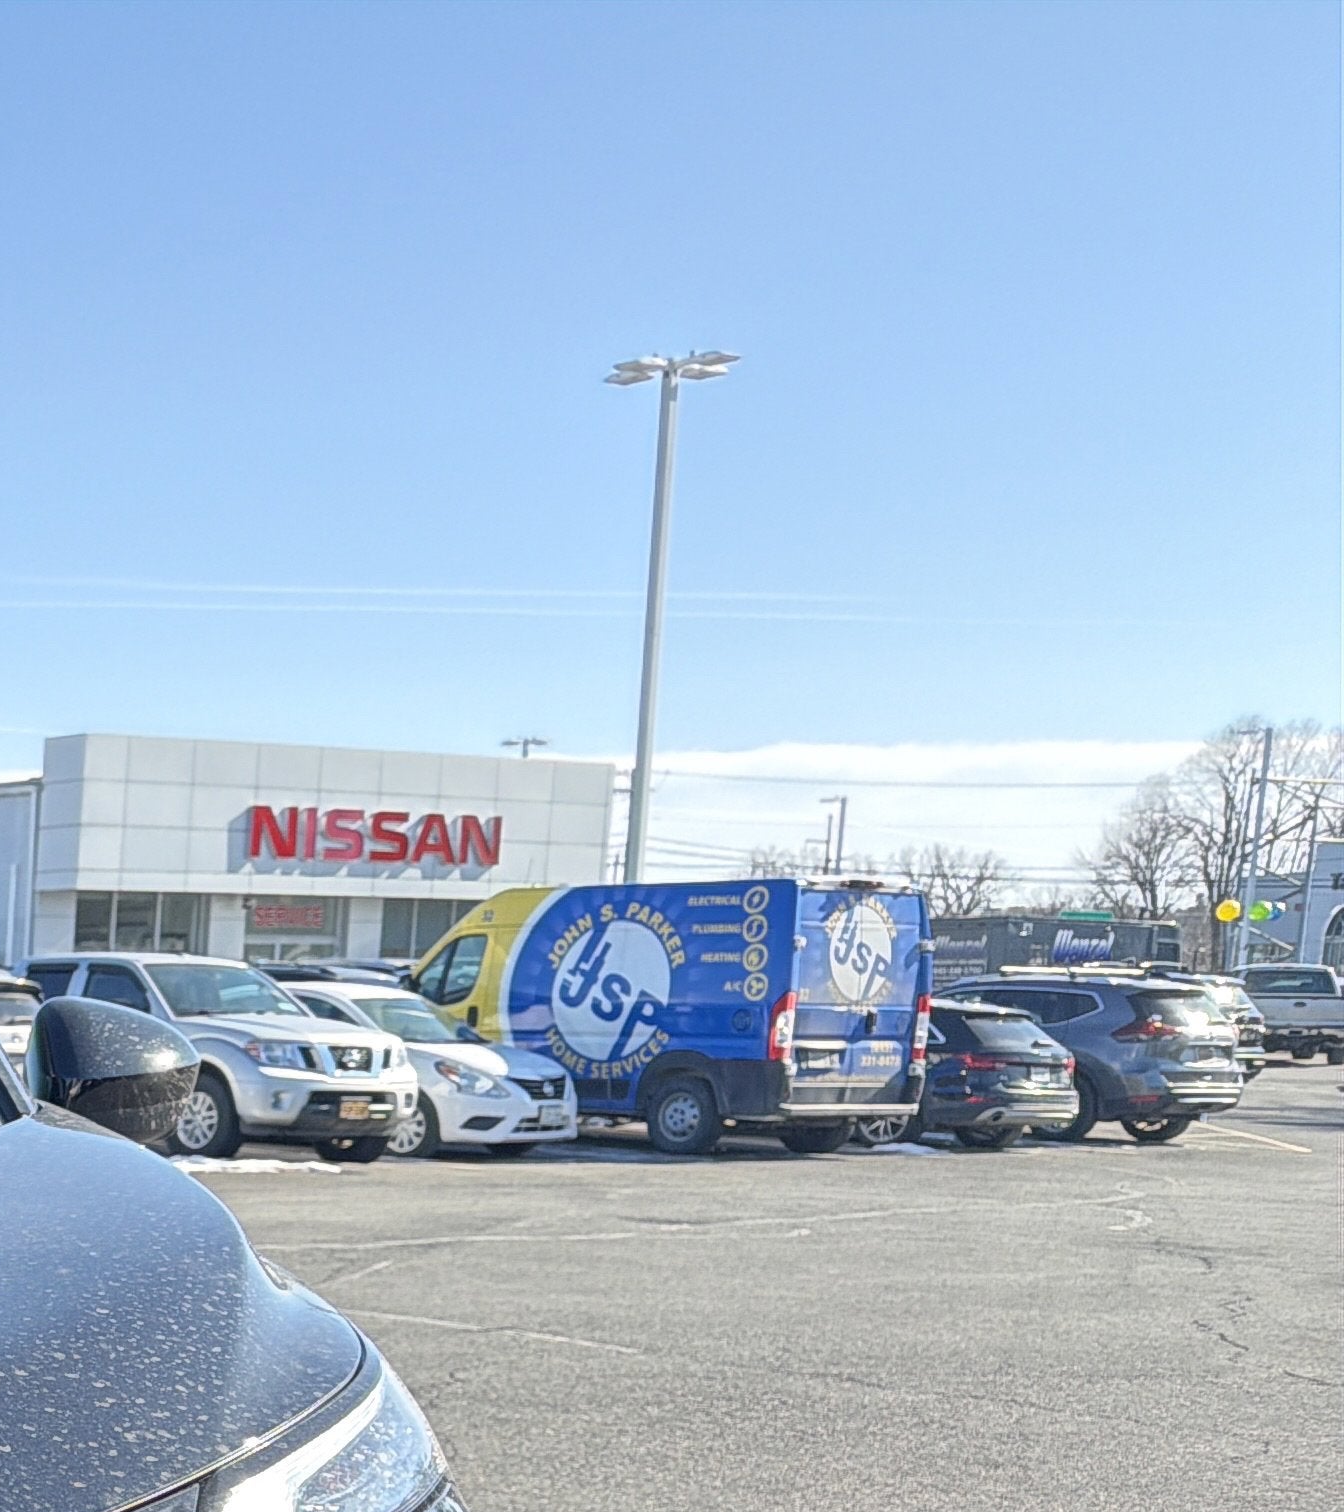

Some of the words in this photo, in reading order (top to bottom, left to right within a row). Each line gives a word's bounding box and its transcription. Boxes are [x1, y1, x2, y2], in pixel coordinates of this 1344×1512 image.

[249, 805, 502, 867] NISSAN
[687, 895, 741, 907] ELECTRICAL
[255, 904, 323, 929] SERVICE
[692, 923, 742, 935] PLUMBING
[548, 913, 592, 969] JOHN
[600, 903, 618, 922] S.
[626, 902, 686, 969] PARKER
[700, 951, 742, 963] HEATING
[559, 921, 669, 1061] JSP
[723, 981, 742, 992] A/C
[546, 1027, 587, 1074] HOME
[592, 1029, 670, 1079] SERVICES
